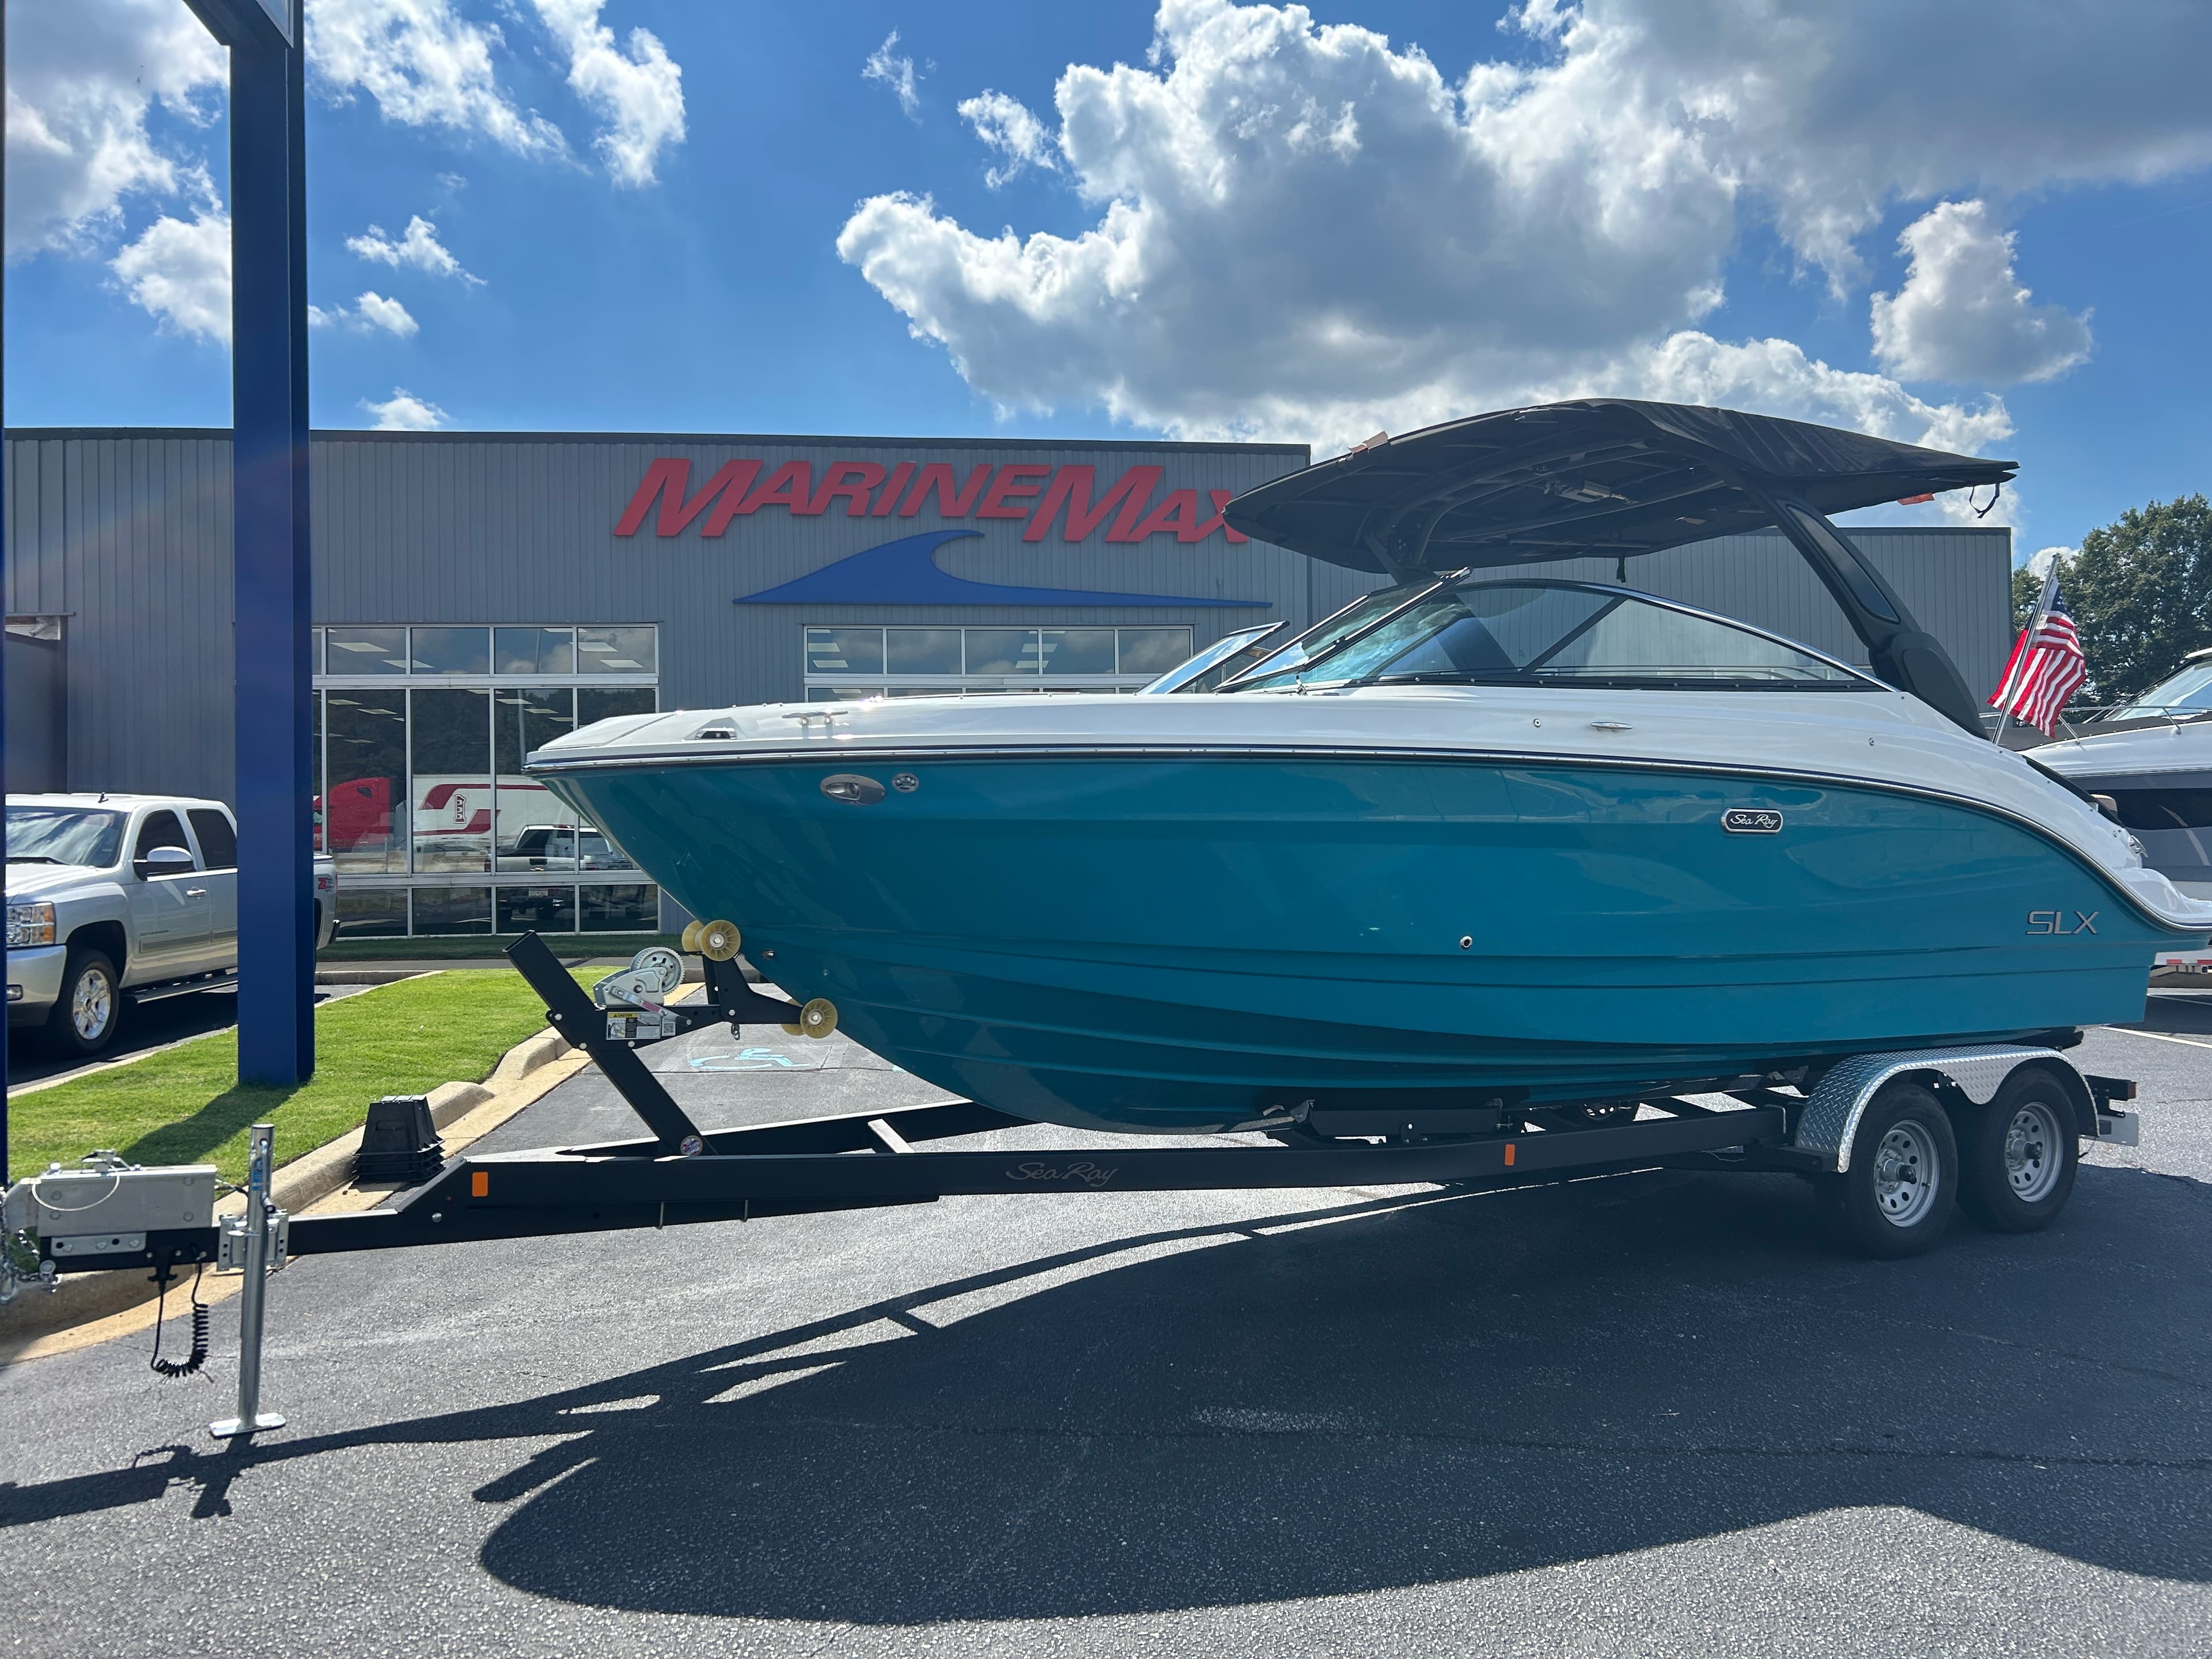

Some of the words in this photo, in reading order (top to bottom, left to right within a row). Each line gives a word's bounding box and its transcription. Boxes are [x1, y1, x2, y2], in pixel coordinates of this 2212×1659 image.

[1730, 814, 1754, 825] Sea
[1754, 814, 1778, 828] Ray
[2026, 910, 2100, 935] SLX
[1006, 1162, 1064, 1180] Sea
[1061, 1161, 1119, 1187] Ray
